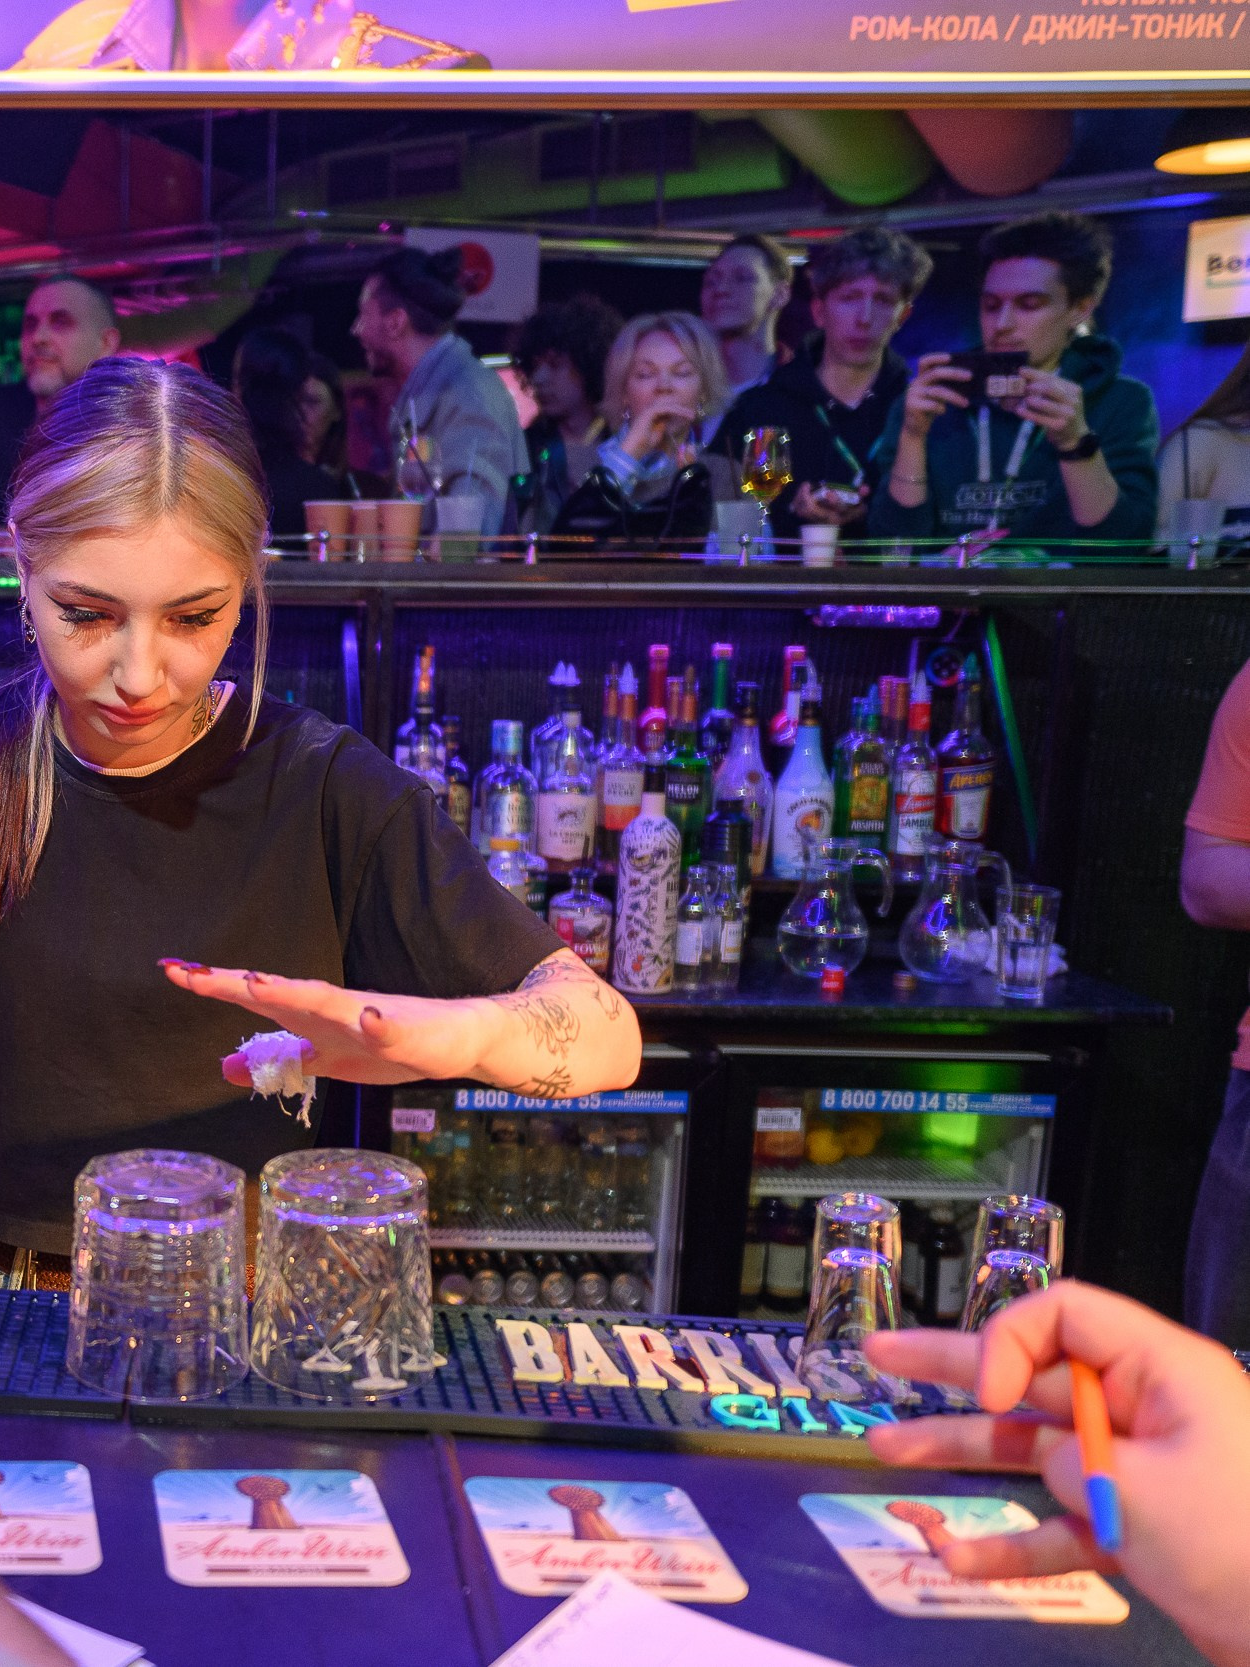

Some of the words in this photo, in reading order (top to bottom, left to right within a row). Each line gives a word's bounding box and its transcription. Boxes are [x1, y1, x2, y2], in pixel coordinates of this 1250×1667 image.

[850, 15, 999, 42] РОМ-КОЛА
[1022, 13, 1226, 45] ДЖИН-ТОНИК
[457, 1089, 469, 1109] 8
[474, 1089, 509, 1109] 800
[824, 1088, 836, 1108] 8
[841, 1089, 877, 1110] 800
[881, 1090, 915, 1111] 700
[919, 1091, 940, 1111] 14
[946, 1093, 968, 1114] 55
[710, 1393, 900, 1436] GIN
